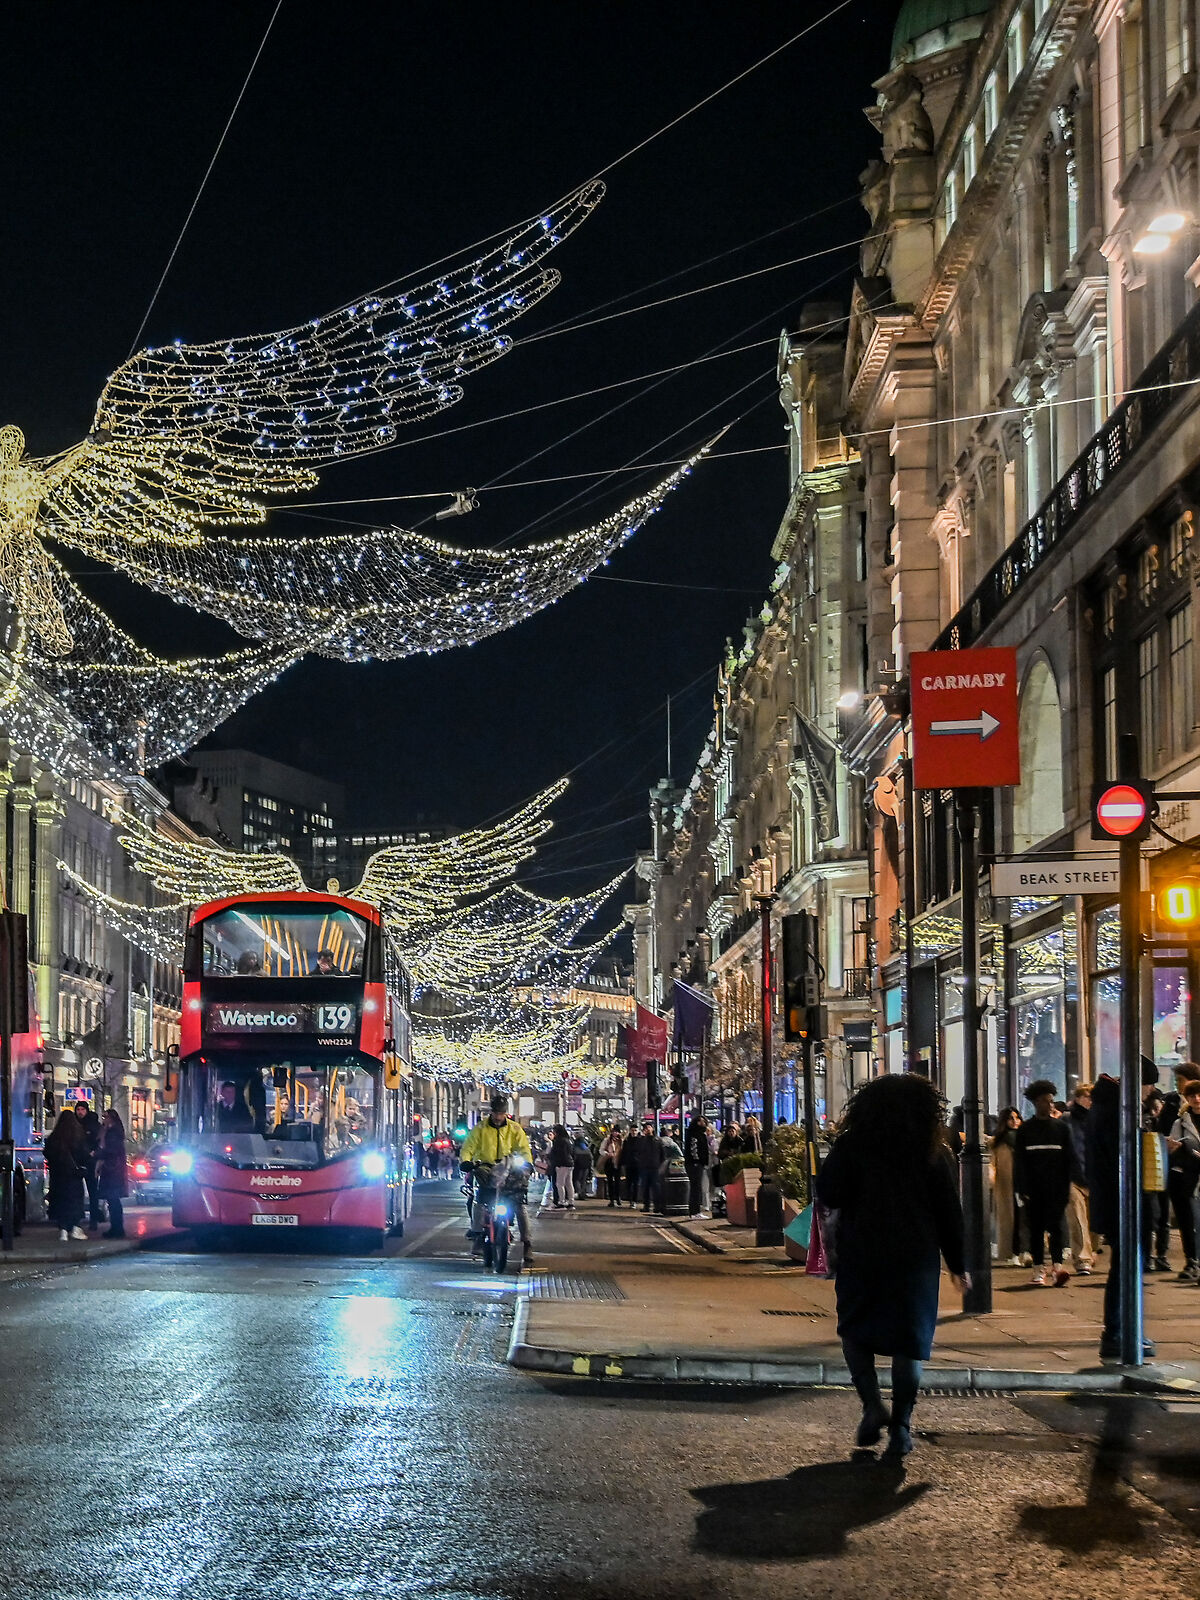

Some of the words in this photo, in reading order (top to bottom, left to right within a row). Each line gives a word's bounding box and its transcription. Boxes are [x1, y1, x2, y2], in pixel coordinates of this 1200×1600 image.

[921, 673, 1006, 690] CARNABY
[1020, 873, 1058, 885] BEAK
[1064, 871, 1119, 883] STREET
[219, 1010, 298, 1026] Waterloo
[318, 1006, 351, 1030] 139
[318, 1038, 353, 1046] VWH2234
[250, 1175, 302, 1187] Metroline
